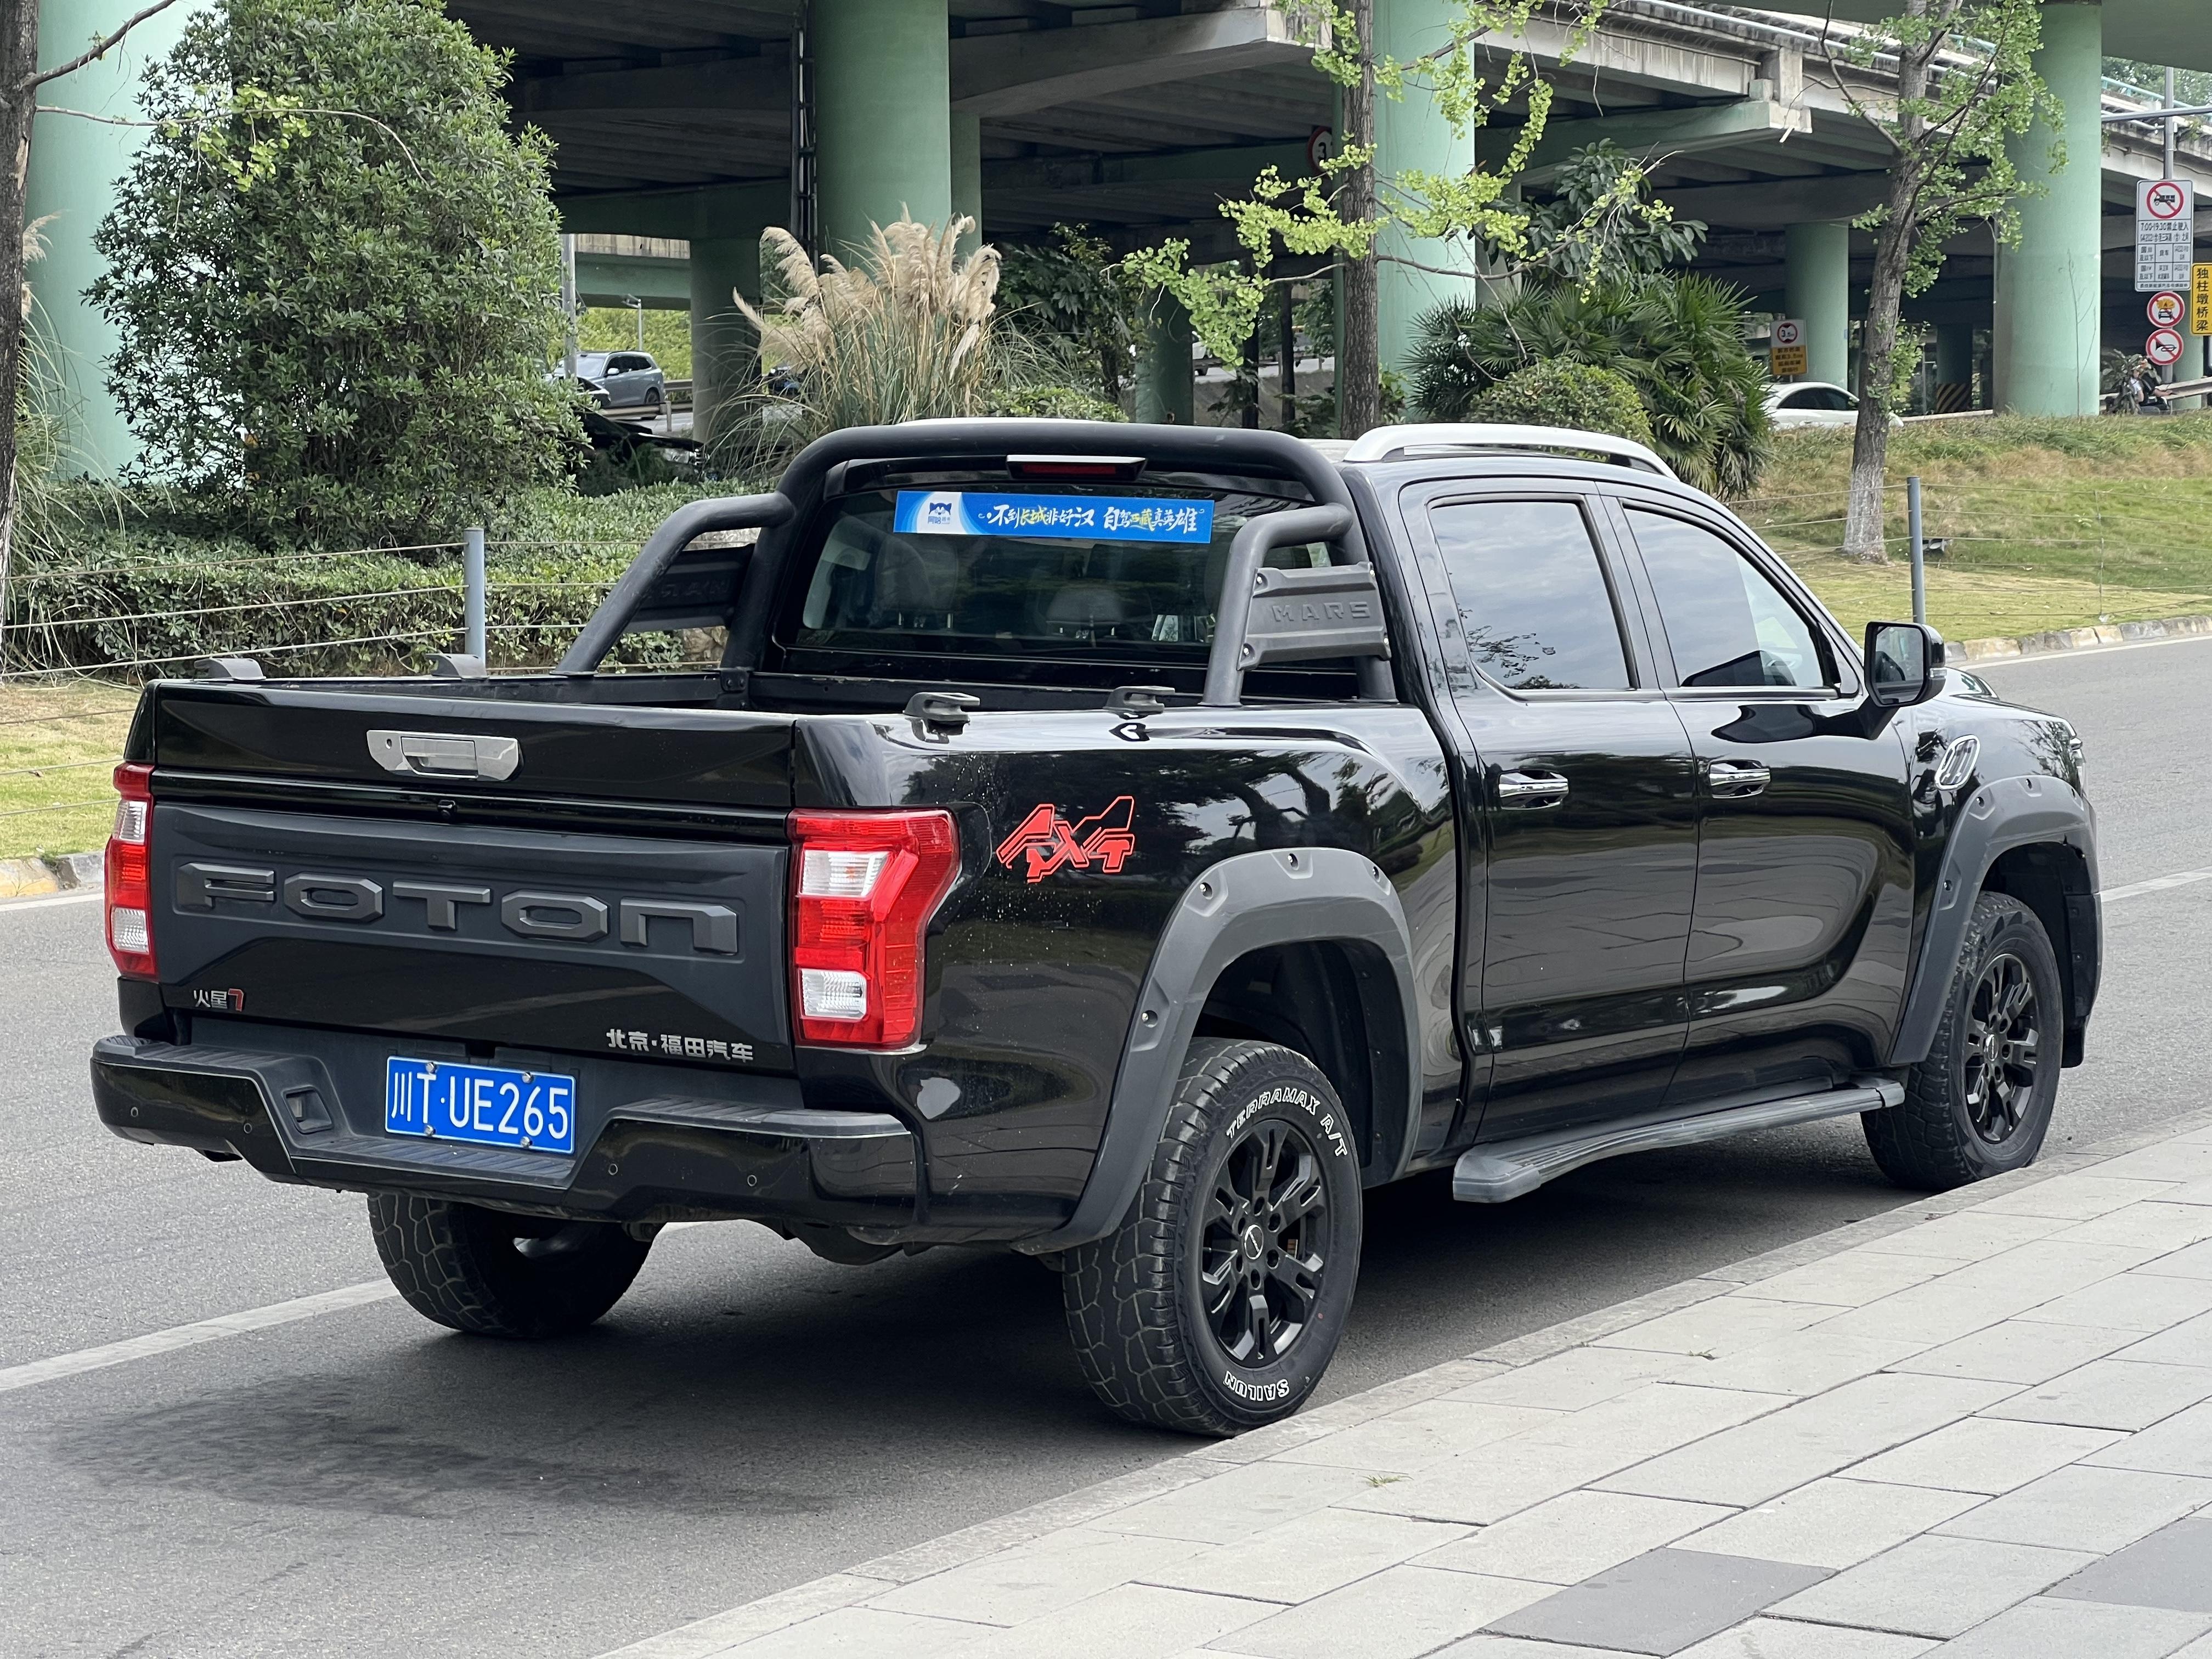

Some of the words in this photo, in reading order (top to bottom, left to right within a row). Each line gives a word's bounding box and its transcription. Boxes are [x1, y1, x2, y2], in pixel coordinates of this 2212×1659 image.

[2196, 267, 2209, 331] 独柱墩桥梁
[988, 504, 1094, 528] 不到长城非好汉
[1272, 601, 1370, 622] MARS
[177, 861, 740, 956] FOTON
[606, 1029, 753, 1063] 北京·福田汽车
[391, 1071, 568, 1139] 川T·UE265
[1226, 1087, 1321, 1138] TERRAMAX
[1320, 1113, 1348, 1156] A/T
[1223, 1370, 1289, 1401] SAILUN
